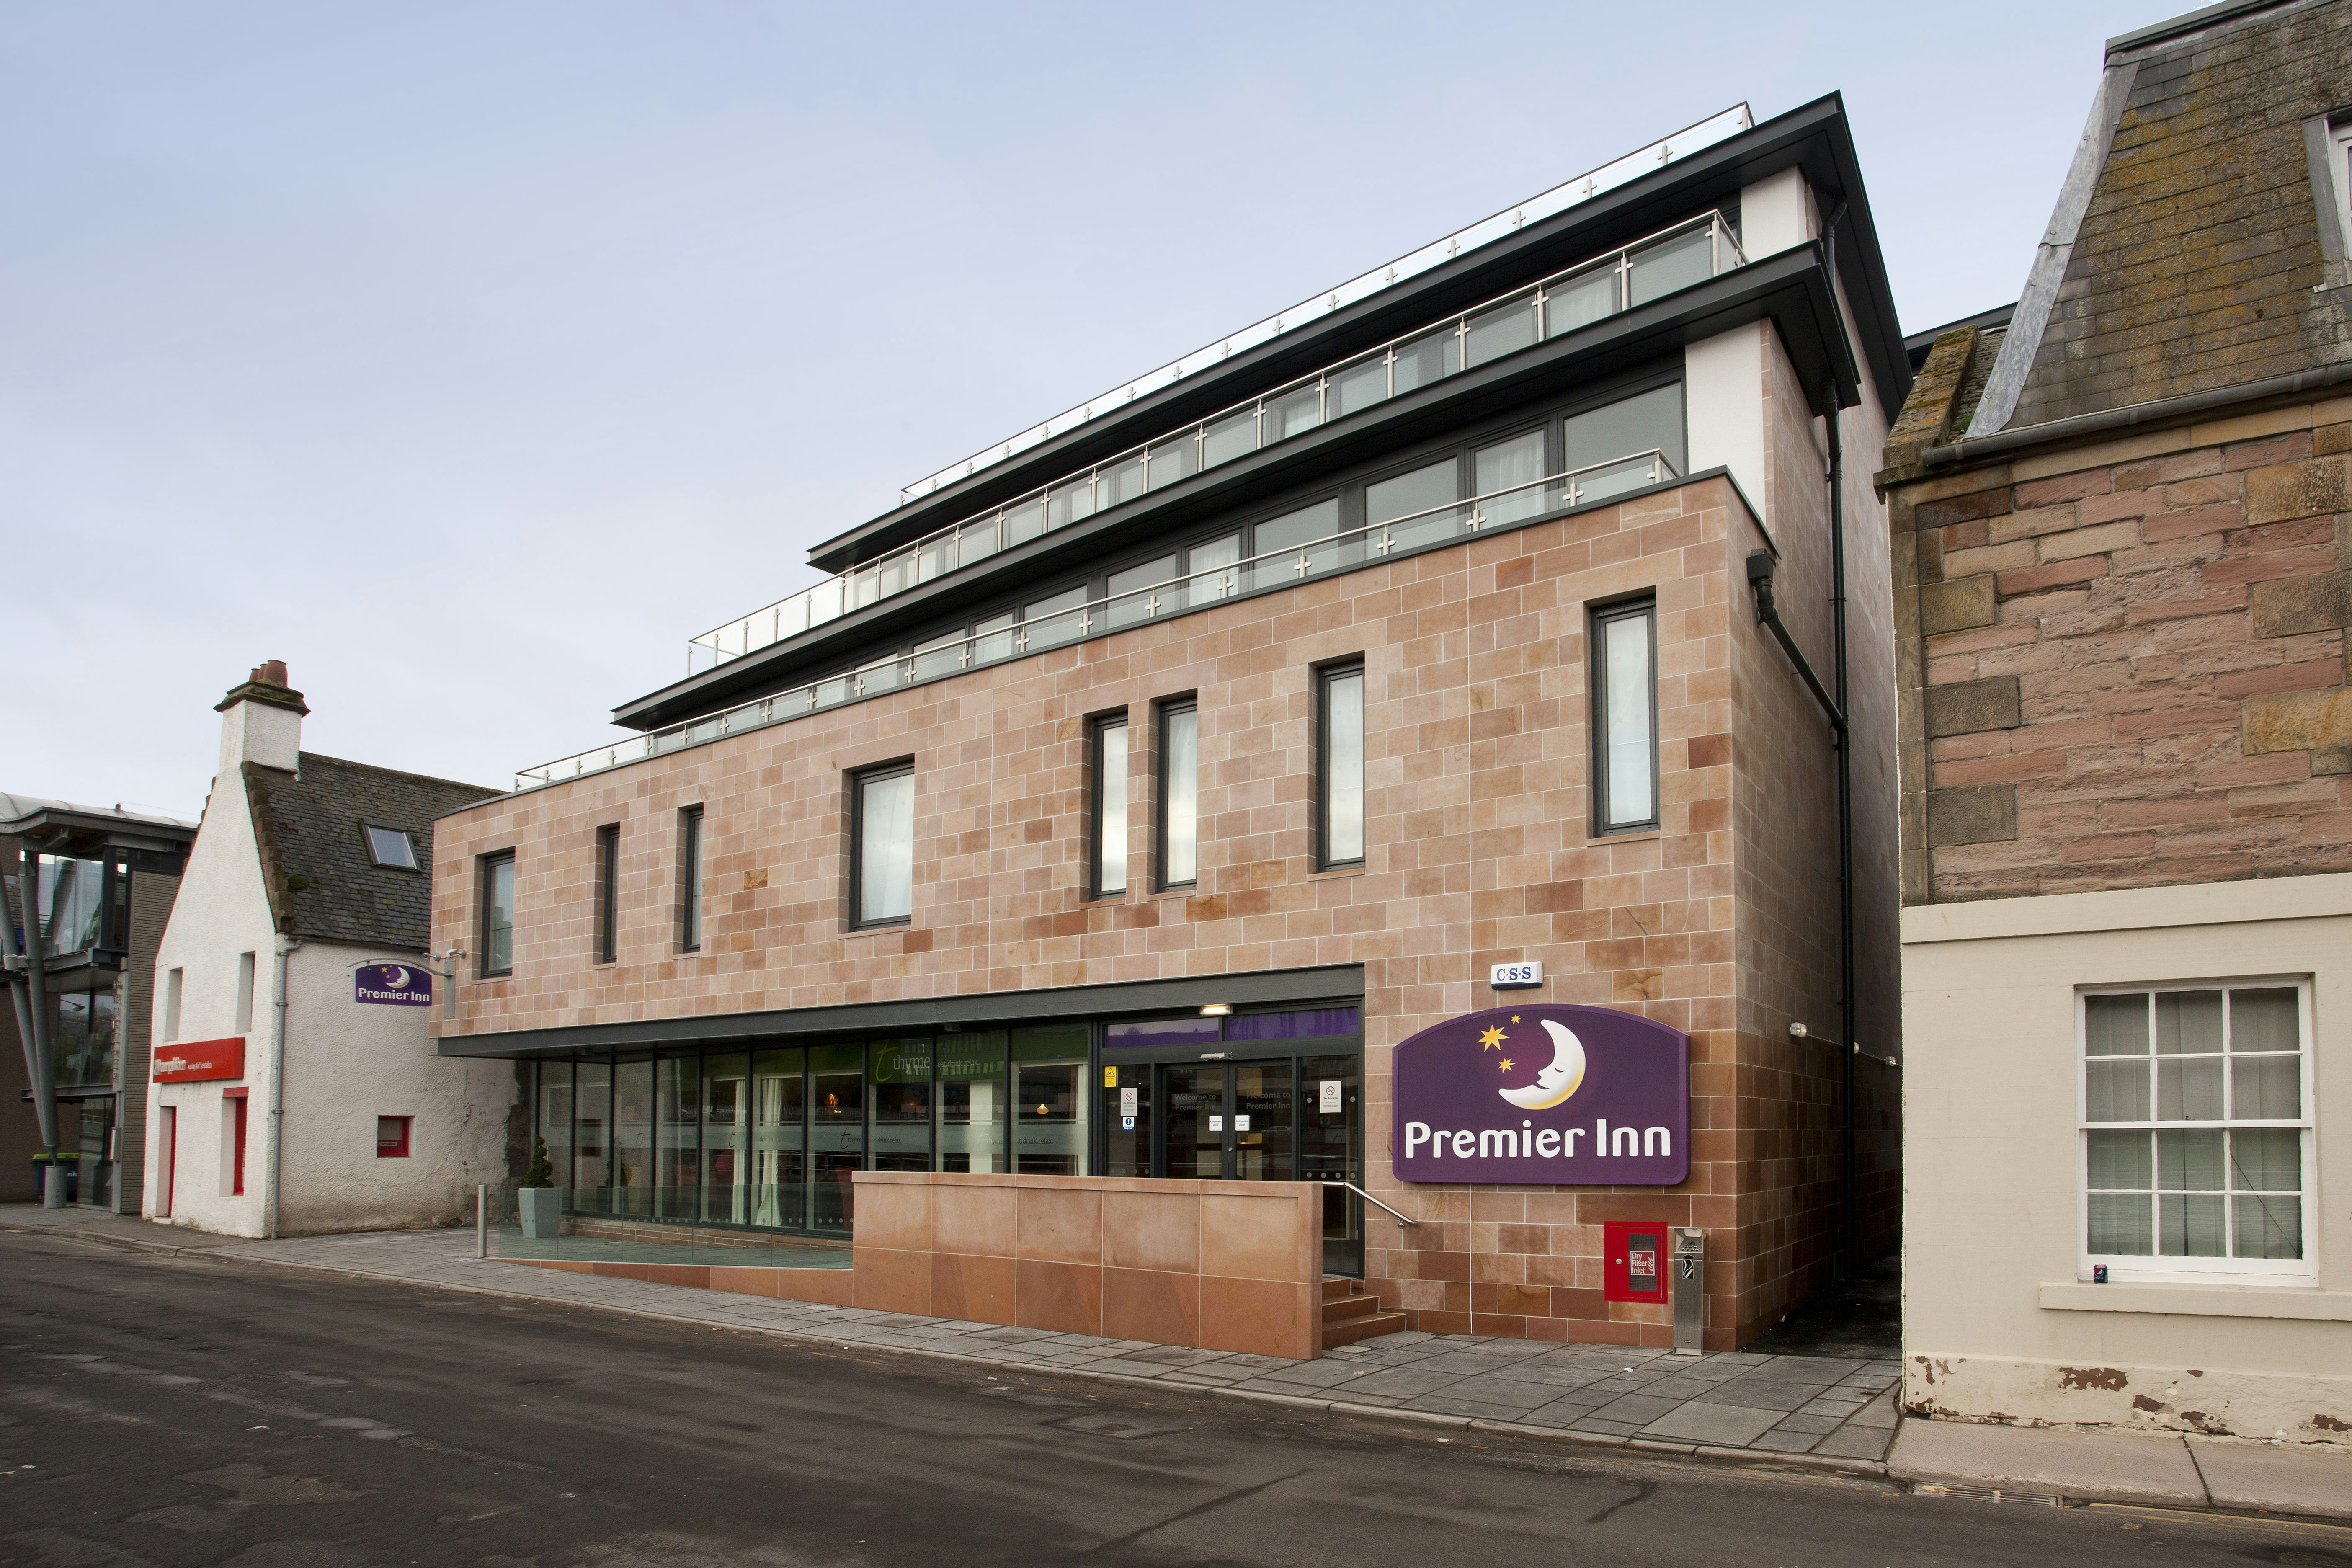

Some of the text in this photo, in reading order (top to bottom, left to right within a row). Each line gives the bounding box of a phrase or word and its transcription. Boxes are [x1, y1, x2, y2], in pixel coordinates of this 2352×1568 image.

[358, 988, 430, 1001] Premier Inn
[893, 1055, 930, 1073] thyme
[1405, 1118, 1671, 1158] Premier Inn
[1632, 1252, 1643, 1261] Dry
